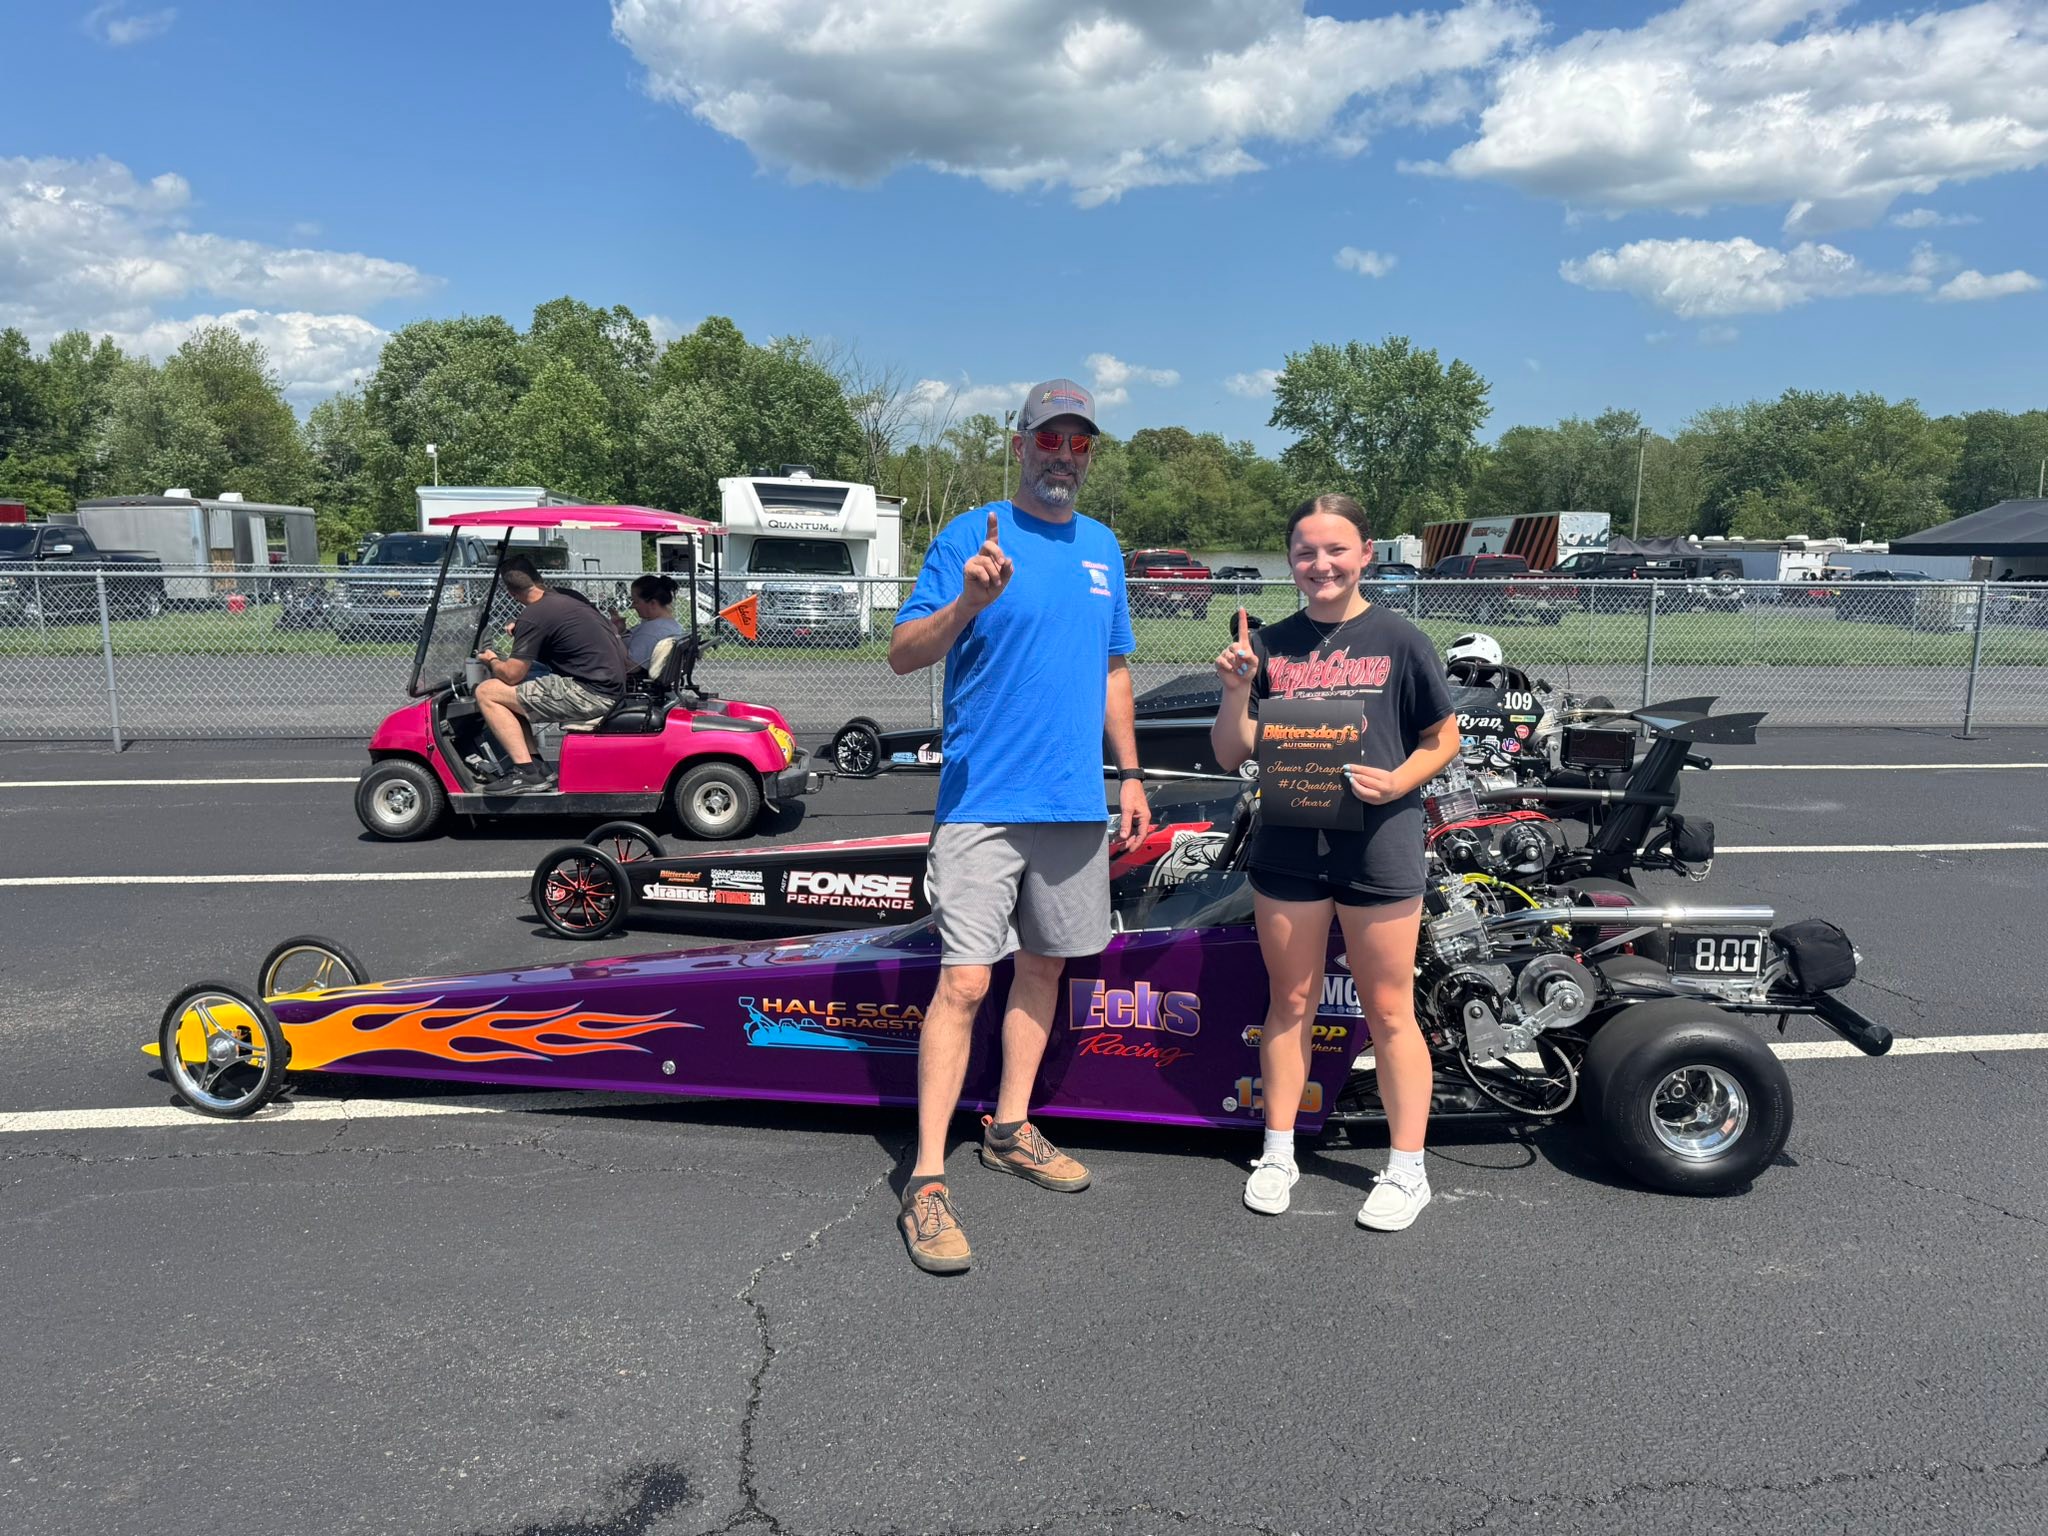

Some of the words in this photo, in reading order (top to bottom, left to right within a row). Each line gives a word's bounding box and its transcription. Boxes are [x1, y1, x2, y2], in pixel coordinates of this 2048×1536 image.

[768, 519, 829, 531] QUANTUM
[1504, 691, 1533, 710] 109
[1456, 713, 1501, 730] Ryan
[1282, 742, 1334, 750] AUTOMOTIVE
[1267, 761, 1303, 774] Junior
[1305, 762, 1344, 775] Dragst
[1278, 779, 1294, 790] #1
[1296, 779, 1343, 792] Qualifier
[1290, 796, 1331, 808] Award
[642, 882, 708, 903] Strange
[787, 870, 913, 899] FONSE
[787, 893, 915, 910] PERFORMANCE
[1695, 938, 1760, 972] 8.00
[763, 998, 847, 1016] HALF
[856, 1003, 925, 1019] SCA
[1069, 978, 1200, 1037] Ecks
[826, 1016, 924, 1031] DRAGST
[1078, 1032, 1194, 1067] Racing
